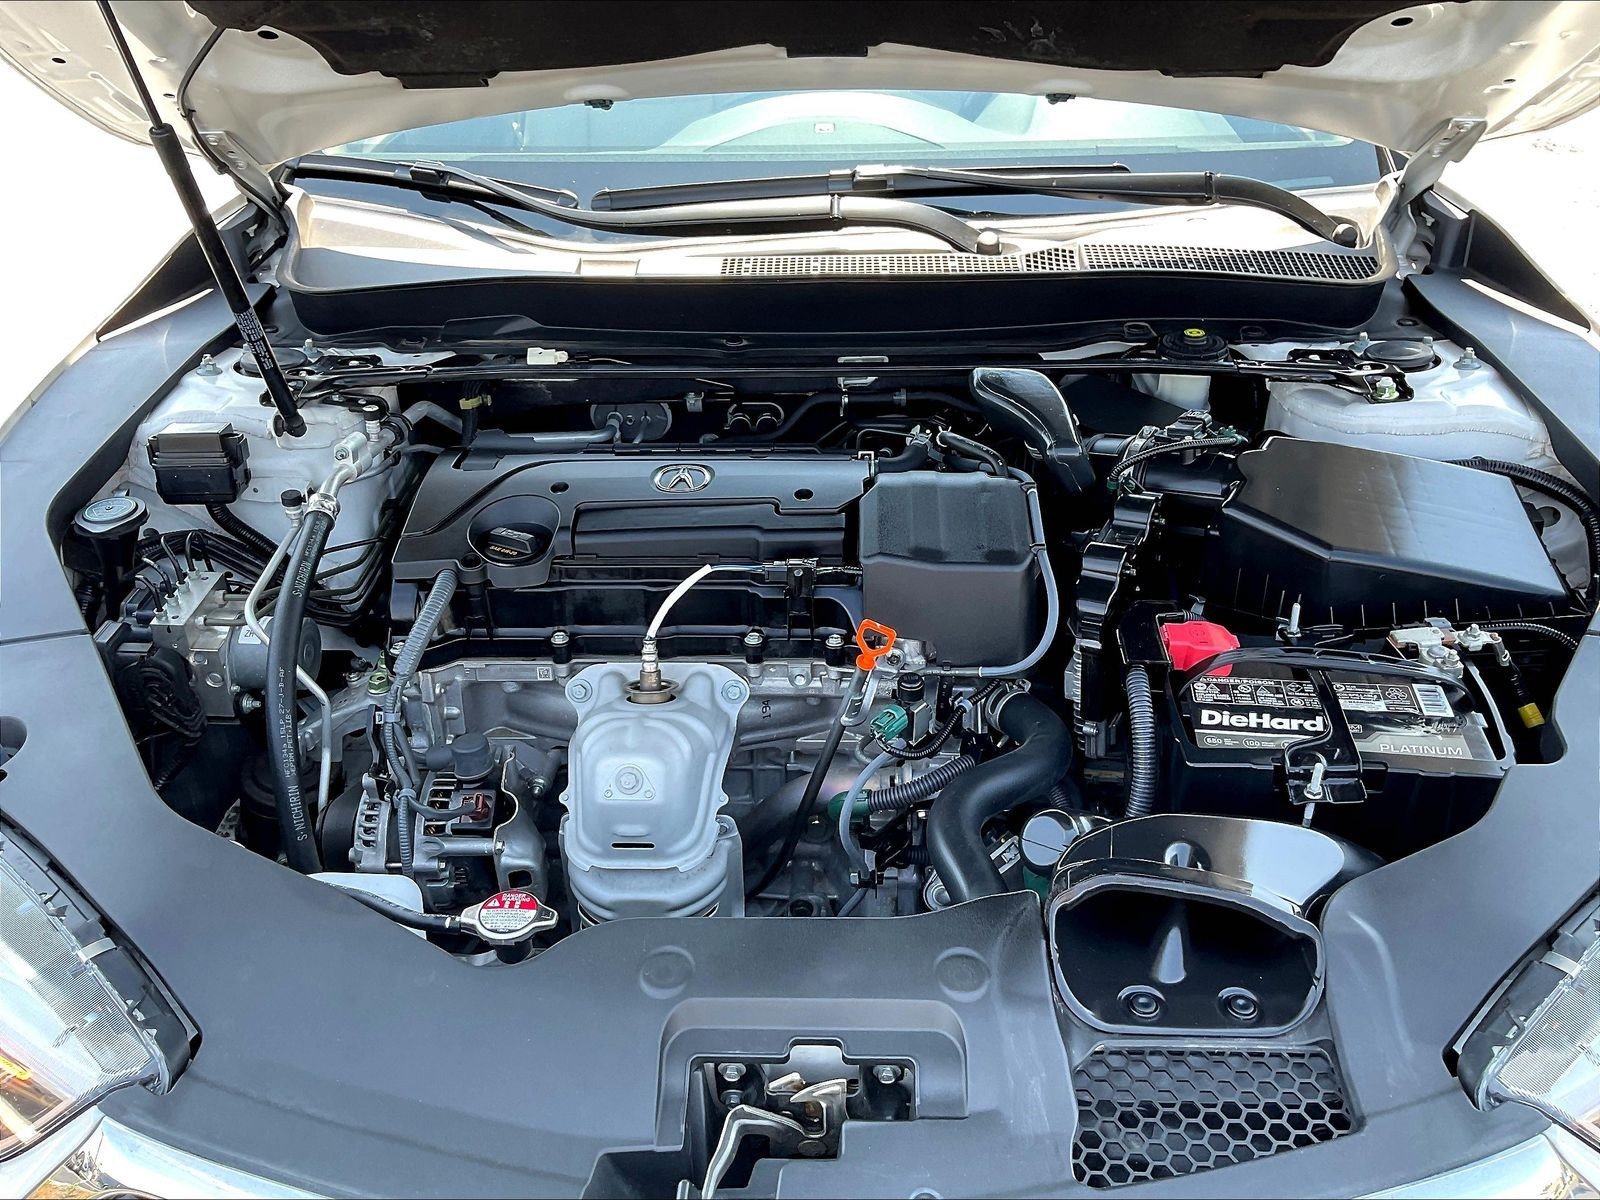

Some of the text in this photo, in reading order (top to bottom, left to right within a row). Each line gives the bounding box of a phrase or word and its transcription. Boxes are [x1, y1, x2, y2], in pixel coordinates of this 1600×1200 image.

[1200, 709, 1324, 732] DieHard
[1206, 736, 1222, 744] 650
[1245, 739, 1260, 747] 100
[1379, 743, 1463, 756] PLATINUM
